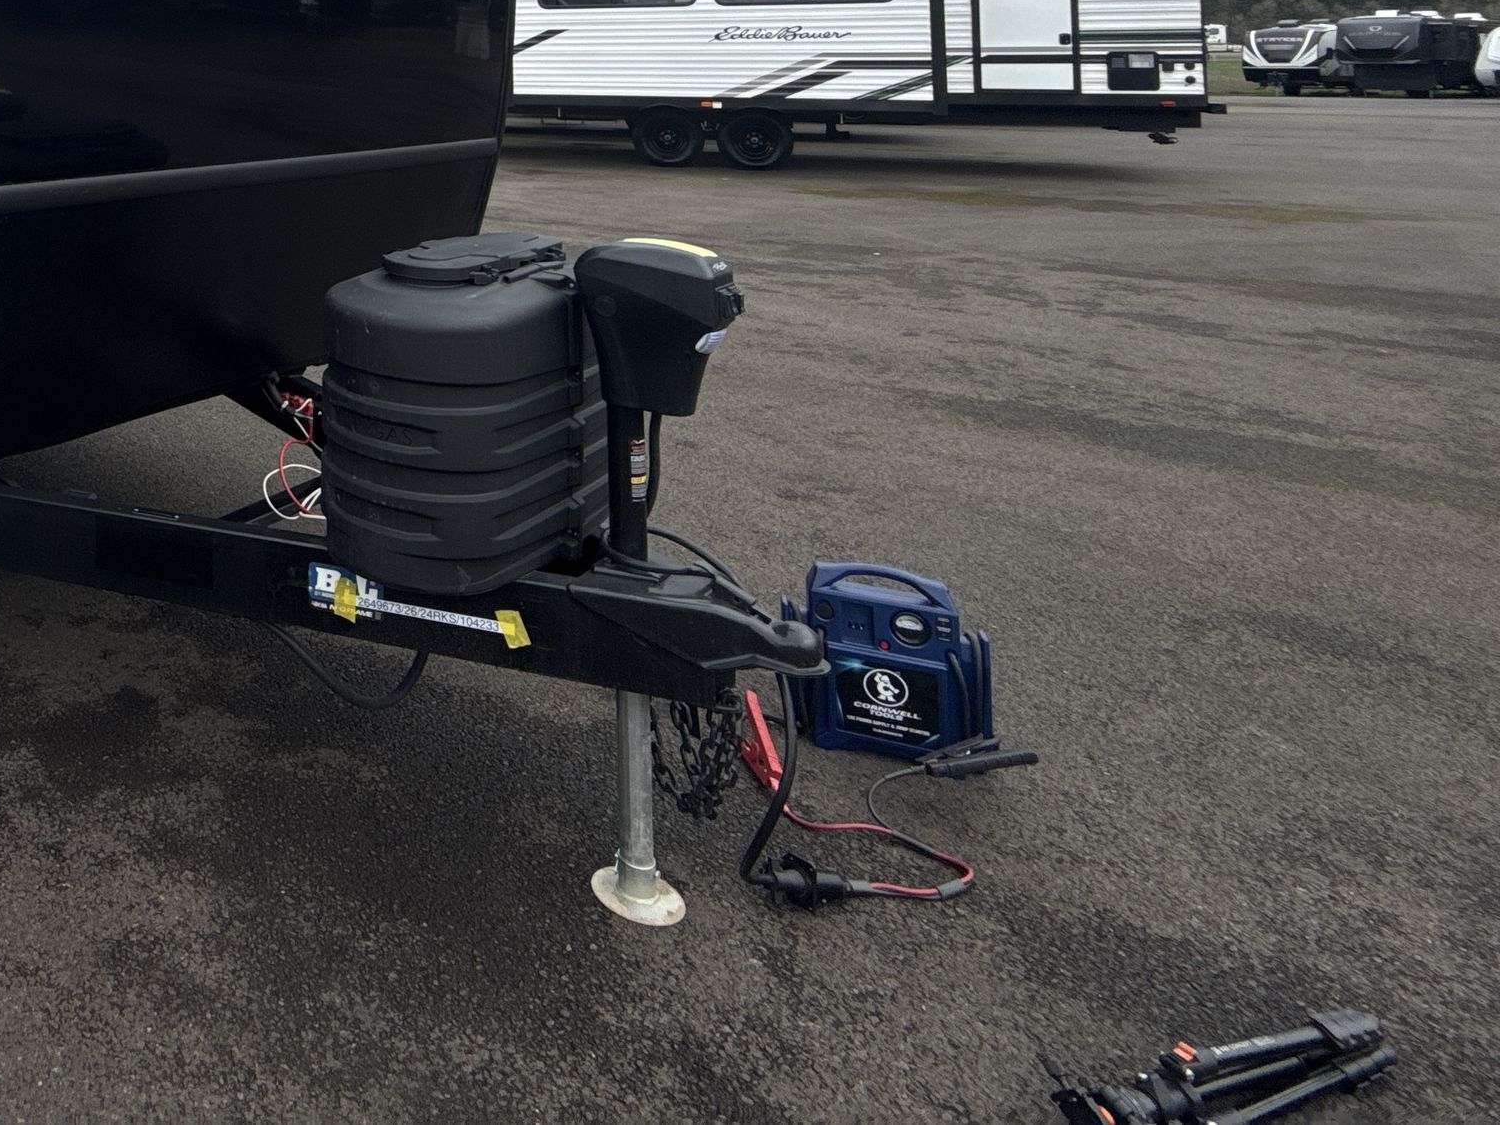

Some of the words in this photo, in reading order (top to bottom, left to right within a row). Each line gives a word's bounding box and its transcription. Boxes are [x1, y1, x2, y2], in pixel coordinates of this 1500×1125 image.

[708, 26, 775, 43] Eddie
[775, 25, 852, 41] Bauer
[853, 701, 919, 720] CORNWELL
[869, 709, 904, 721] TOOLS
